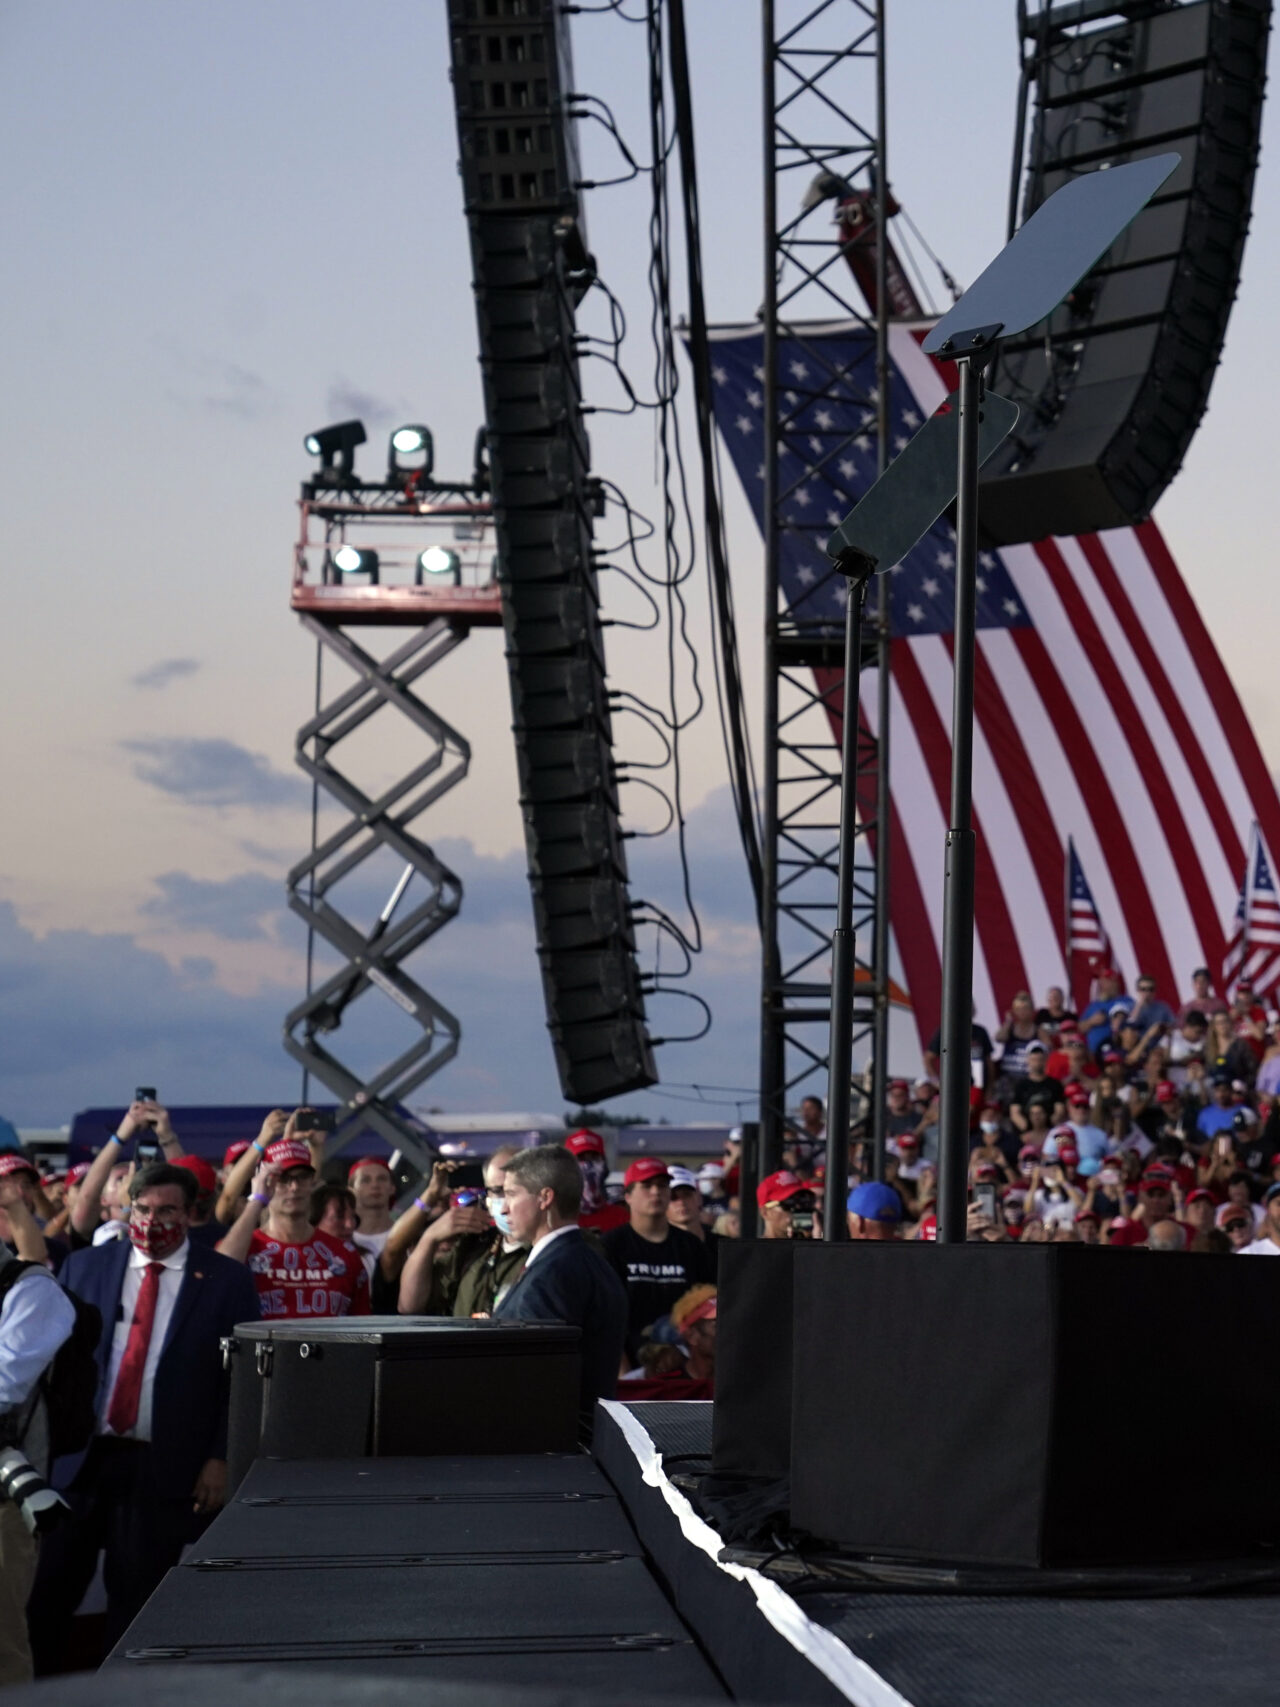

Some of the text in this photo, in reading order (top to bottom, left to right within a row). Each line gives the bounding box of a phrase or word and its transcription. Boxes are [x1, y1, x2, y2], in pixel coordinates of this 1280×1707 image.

[260, 1241, 334, 1270] 2020
[266, 1268, 335, 1280] TRUMP
[626, 1263, 685, 1276] TRUMP
